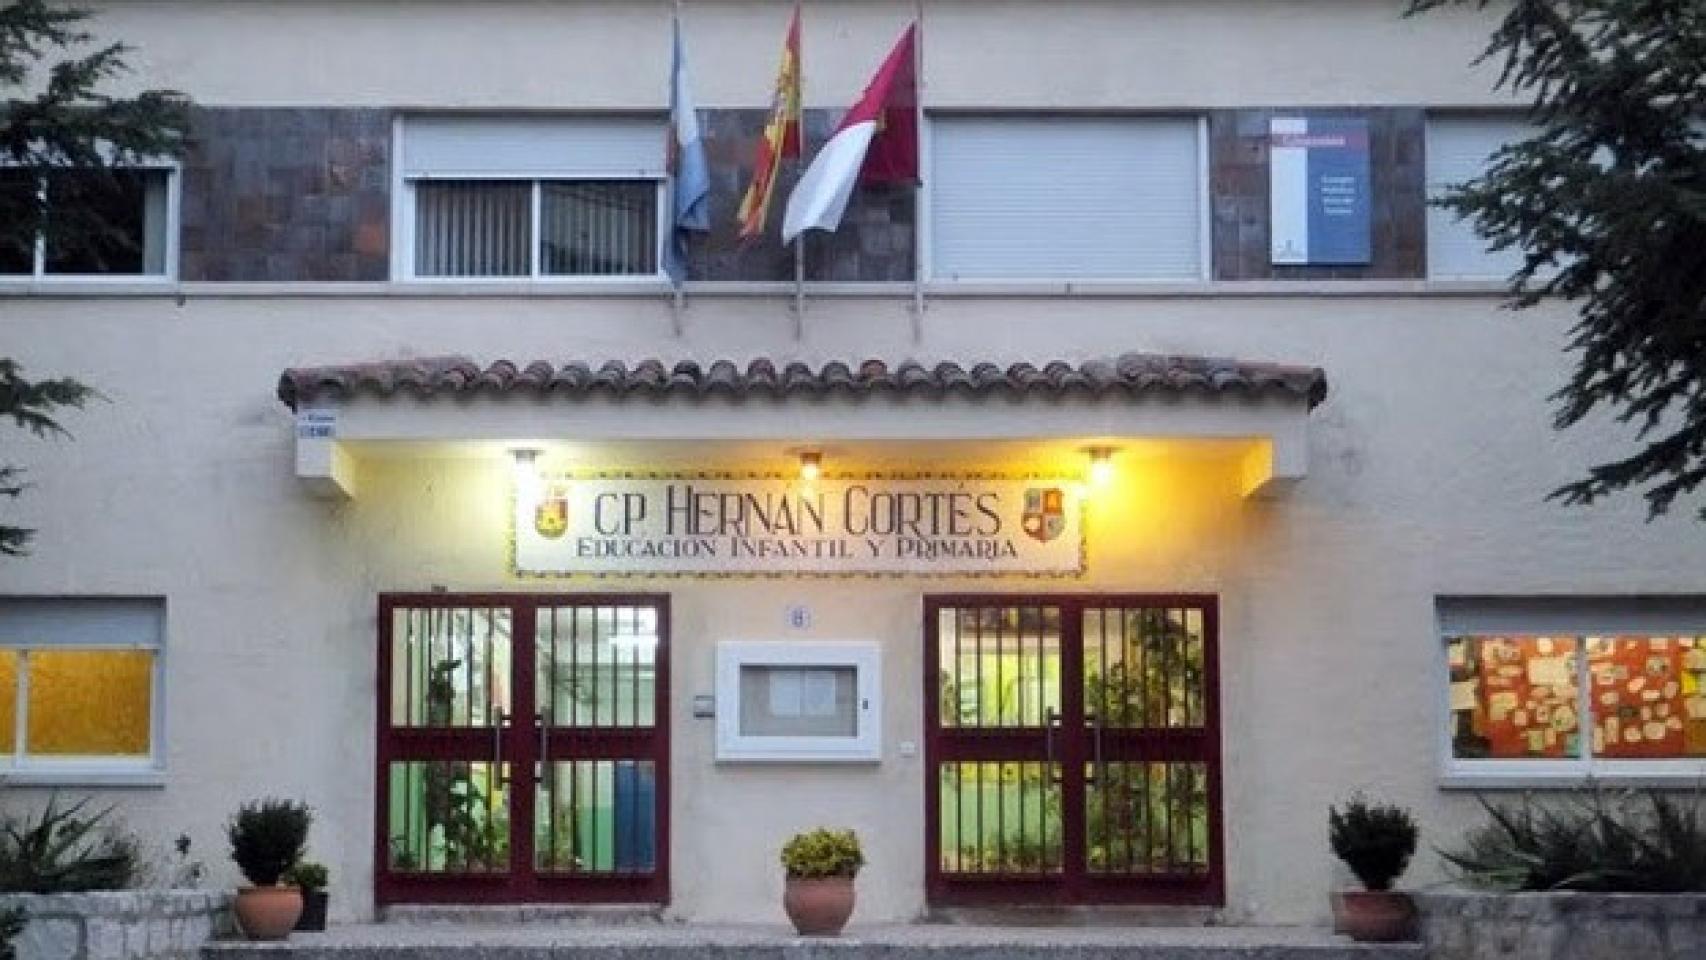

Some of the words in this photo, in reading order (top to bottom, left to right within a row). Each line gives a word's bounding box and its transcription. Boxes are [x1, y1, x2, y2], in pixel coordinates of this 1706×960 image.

[594, 492, 647, 536] CP
[731, 538, 854, 558] INFANTIL
[866, 538, 886, 558] Y
[896, 538, 1018, 561] PRIMARIA
